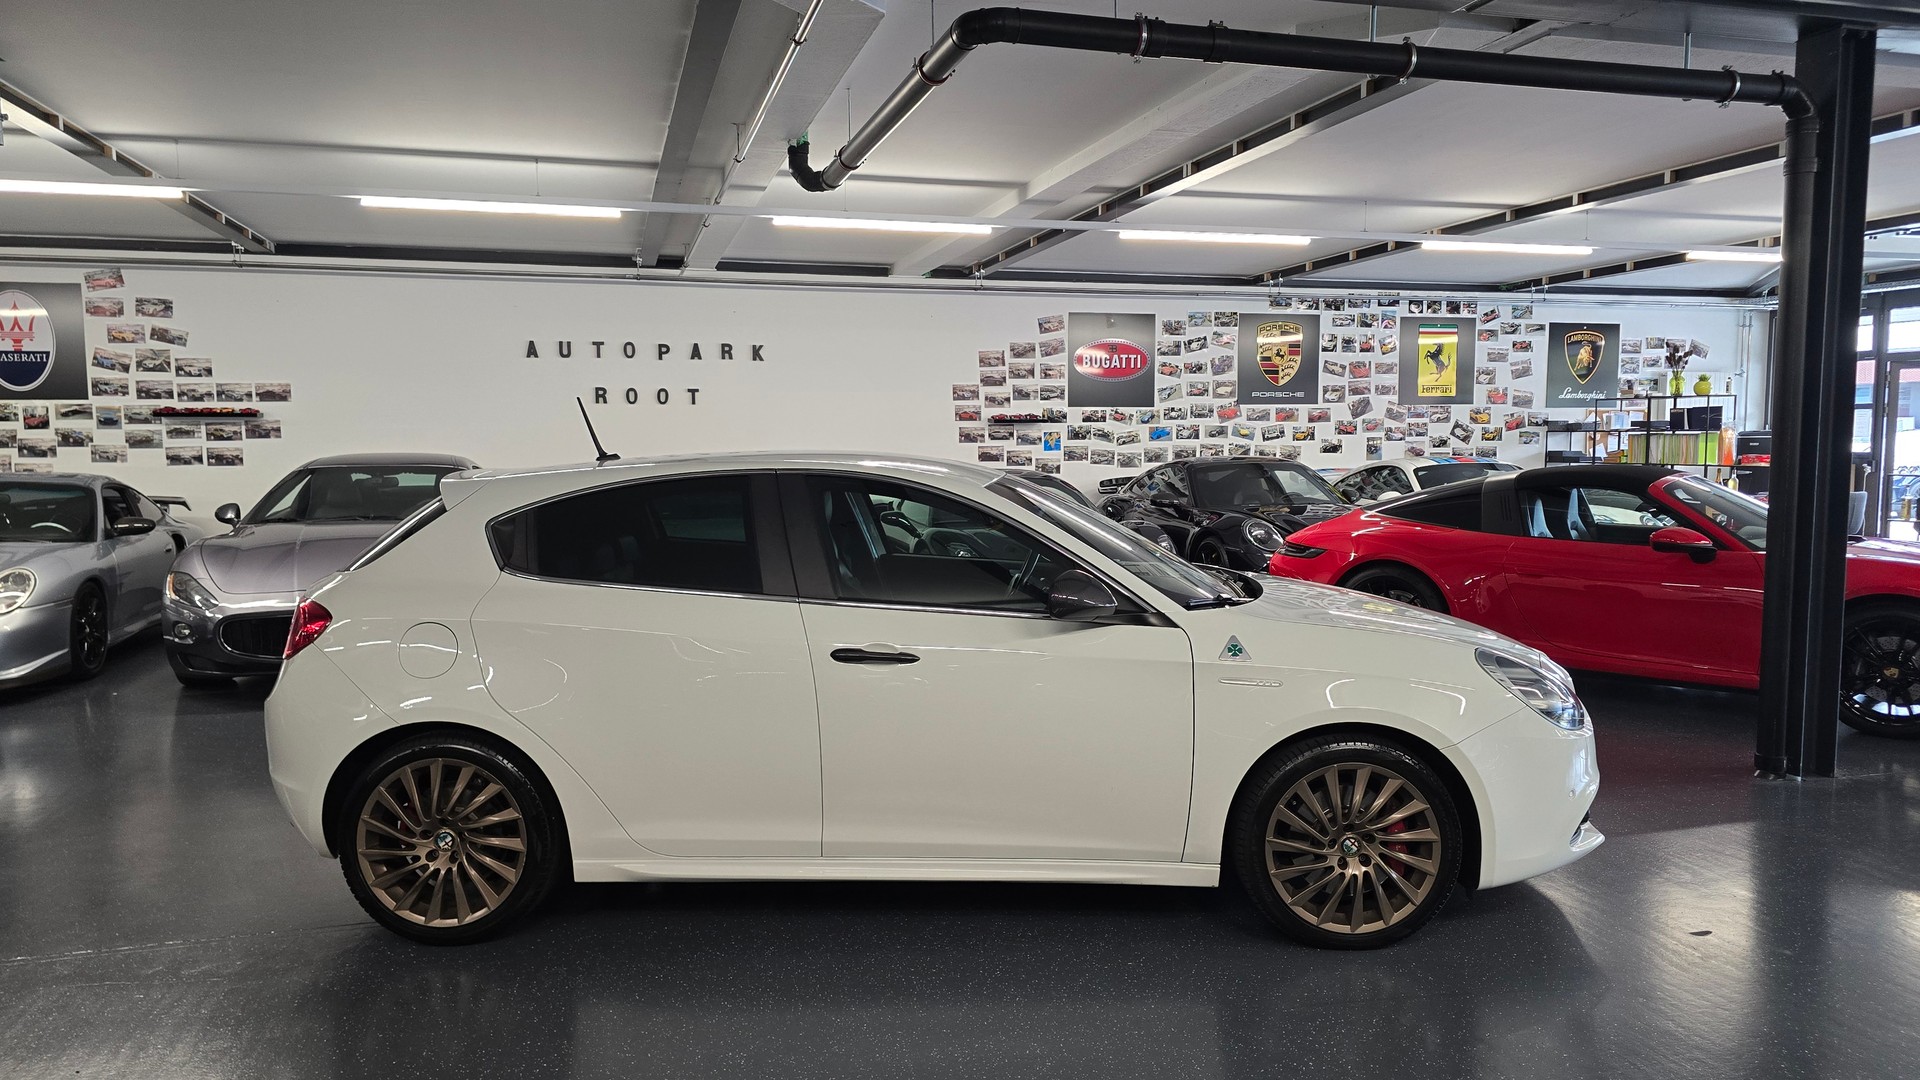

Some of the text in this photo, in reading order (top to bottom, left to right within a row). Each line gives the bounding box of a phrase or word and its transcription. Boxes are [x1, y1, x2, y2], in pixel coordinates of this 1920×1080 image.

[1259, 324, 1301, 334] PORSCHE
[0, 353, 47, 361] ASERATI
[526, 340, 764, 361] AUTOPARK
[1082, 353, 1141, 369] BUGATTI
[594, 387, 700, 405] ROOT
[1421, 384, 1452, 393] Ferrari
[1558, 386, 1607, 401] Lamborghini
